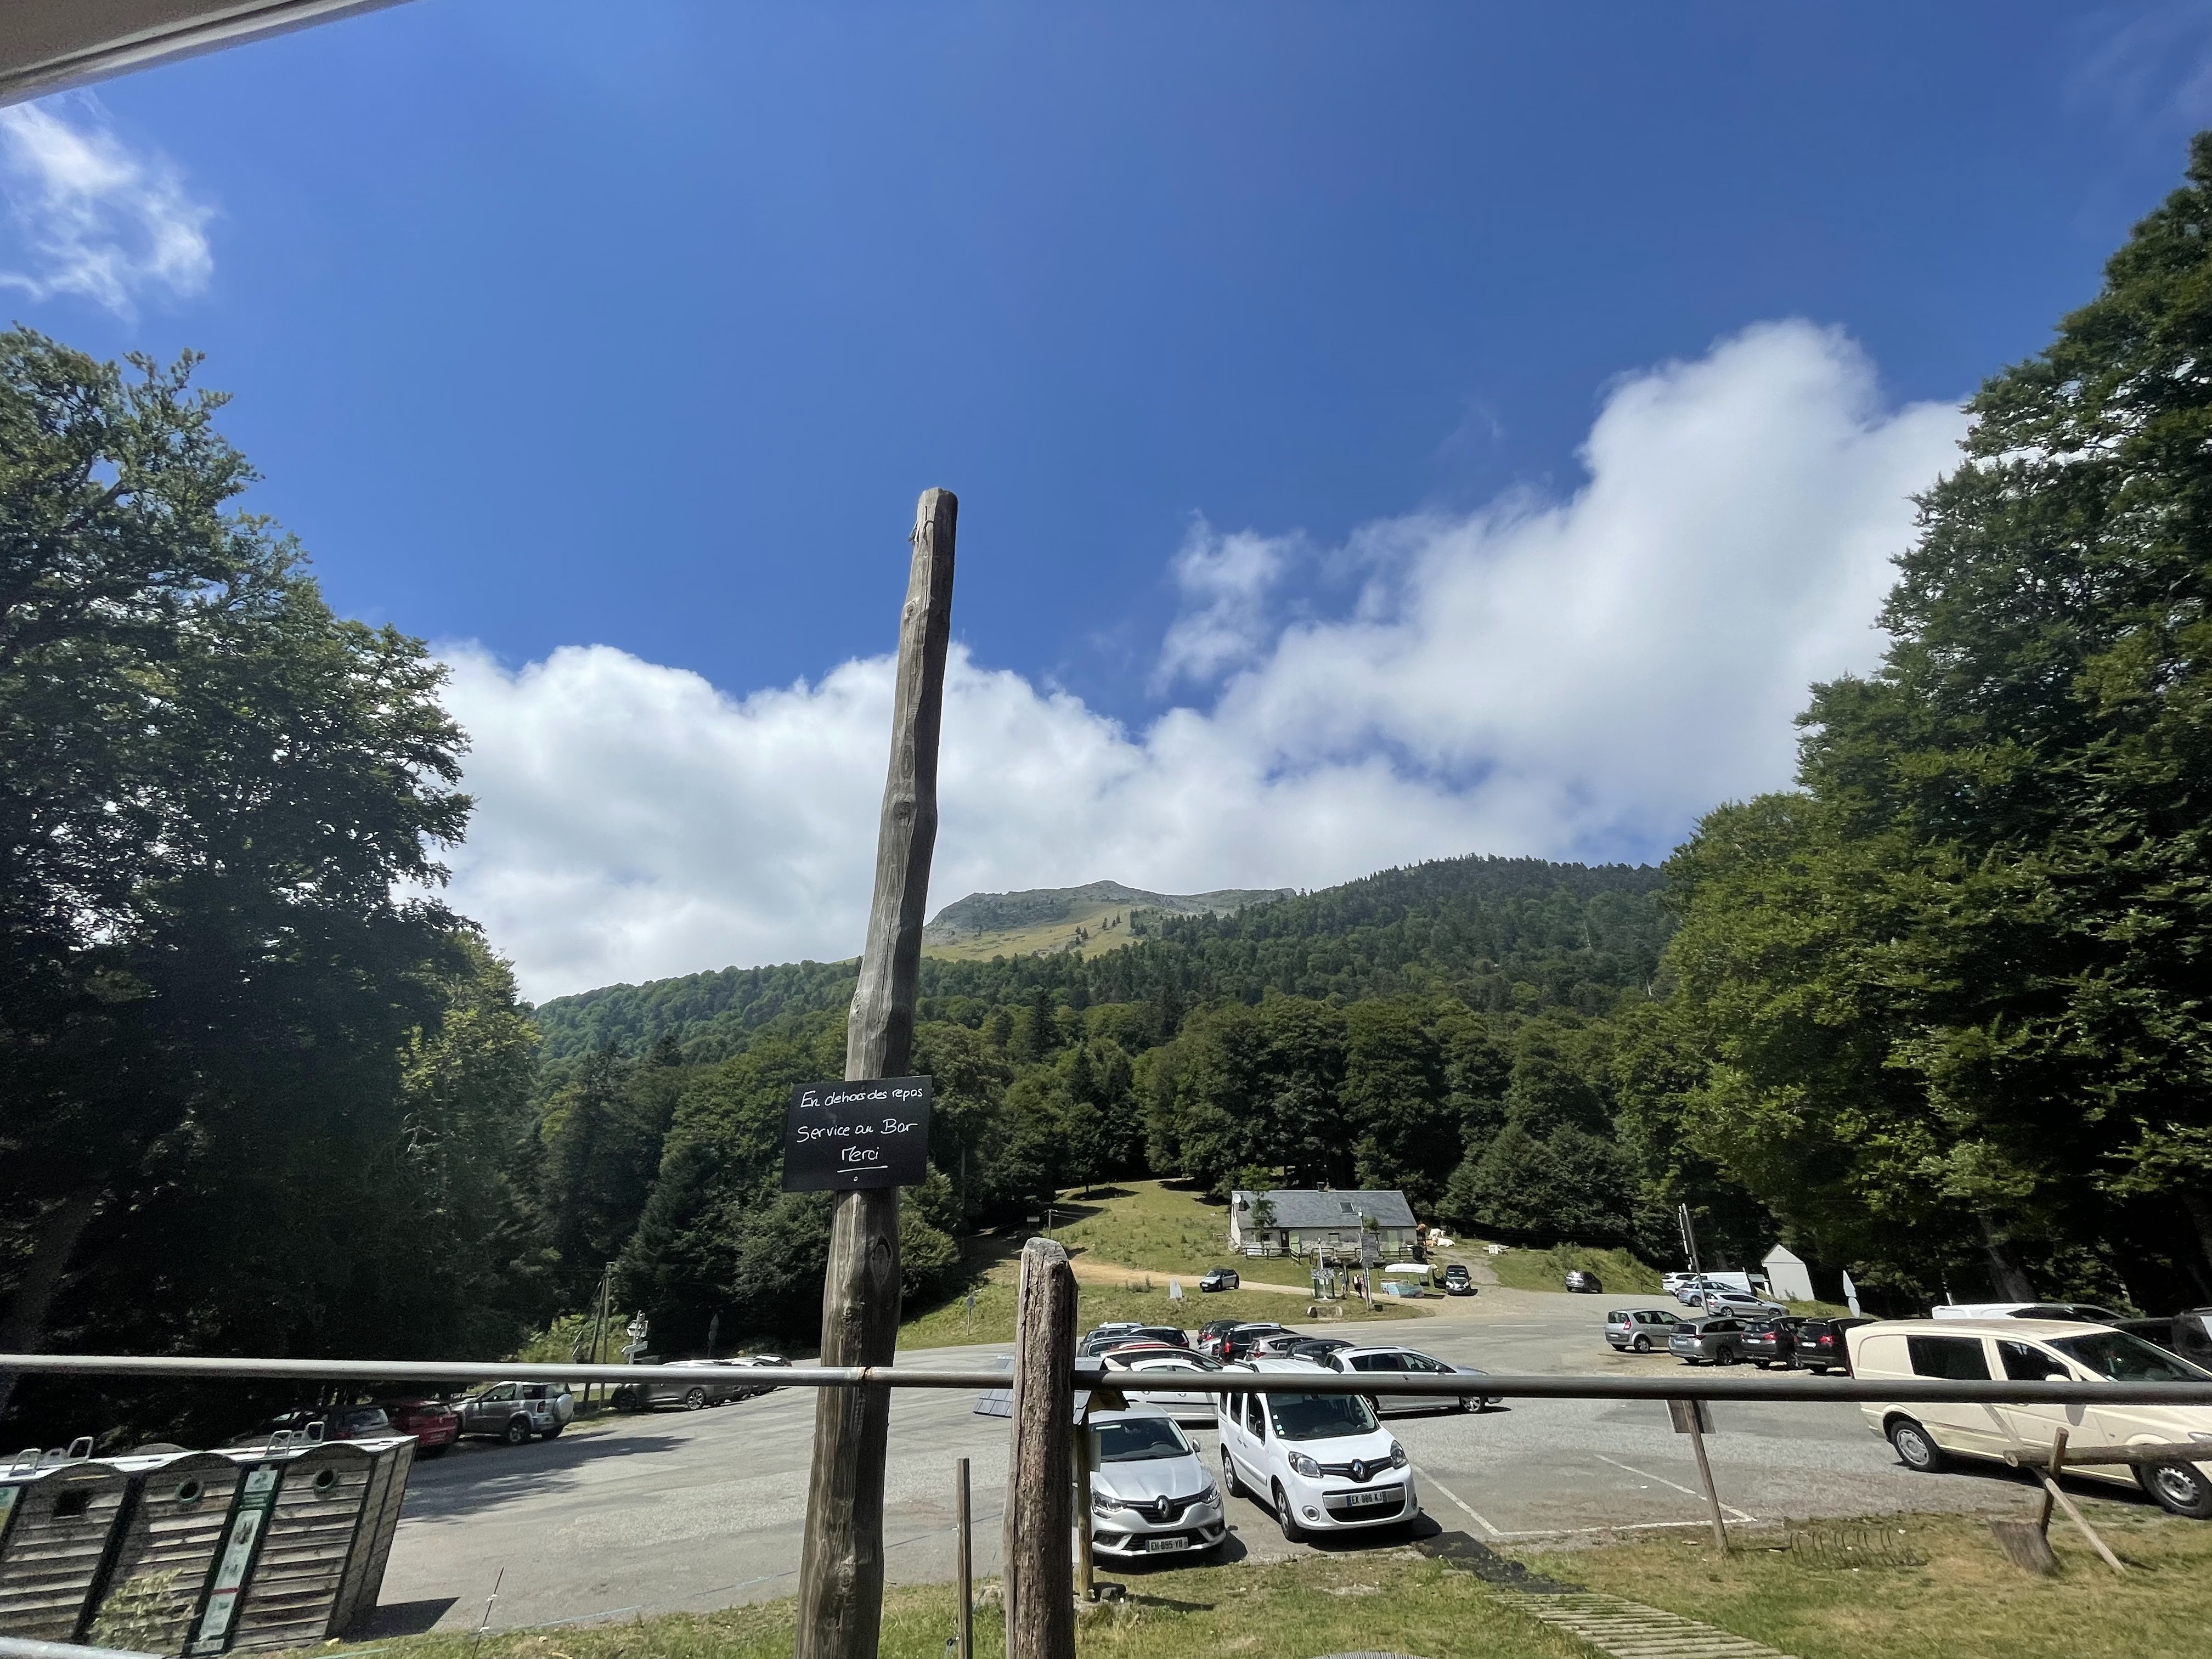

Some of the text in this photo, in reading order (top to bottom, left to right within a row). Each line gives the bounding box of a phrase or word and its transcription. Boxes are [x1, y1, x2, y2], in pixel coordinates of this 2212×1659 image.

[800, 1088, 923, 1108] En dehors des repas
[796, 1118, 918, 1143] Service au Bar
[842, 1146, 879, 1162] Merci
